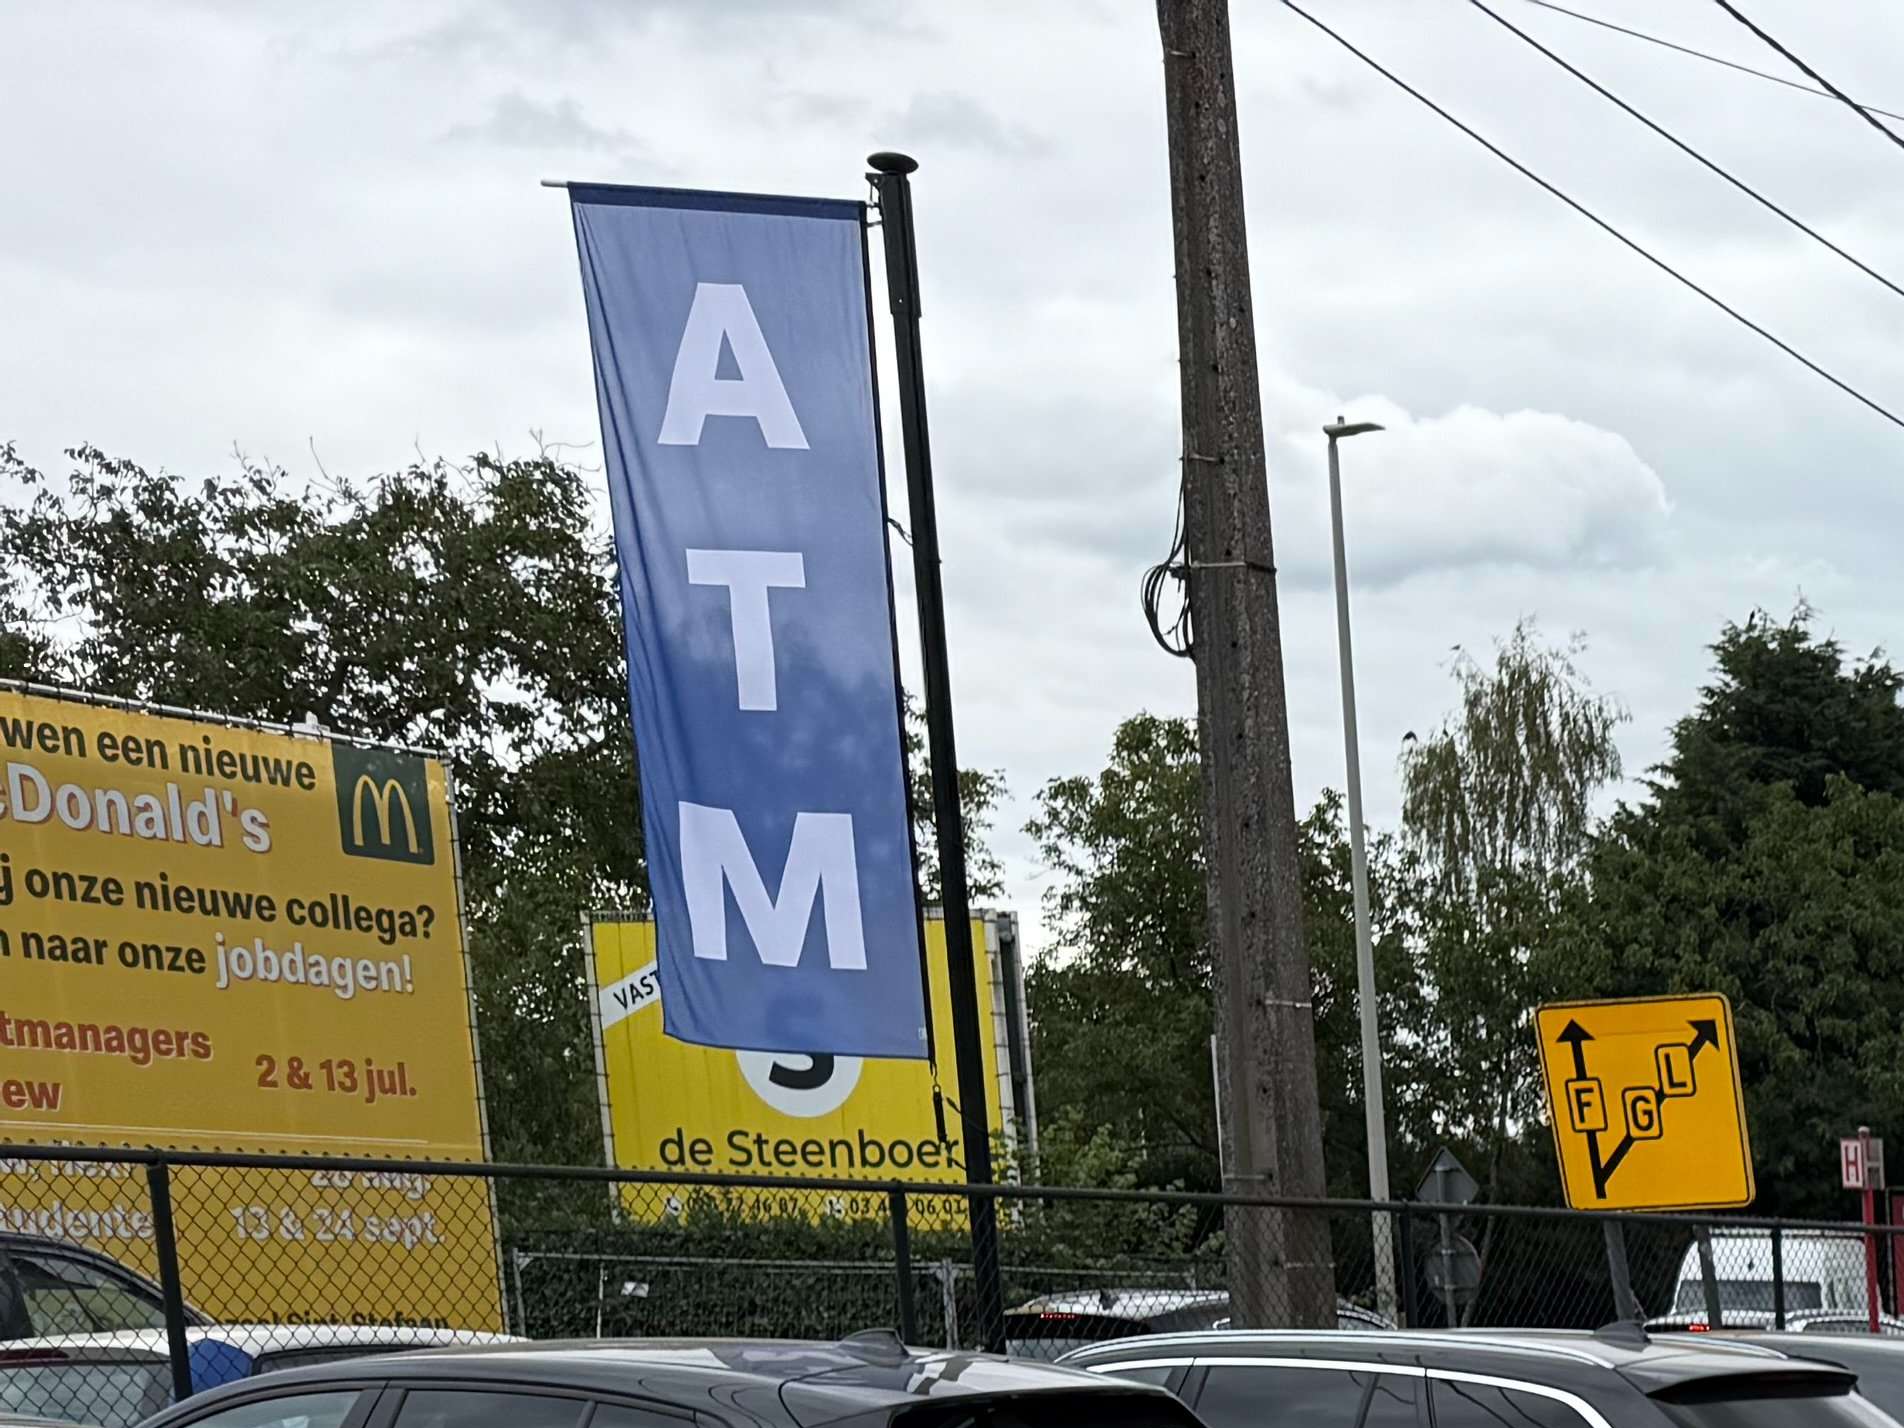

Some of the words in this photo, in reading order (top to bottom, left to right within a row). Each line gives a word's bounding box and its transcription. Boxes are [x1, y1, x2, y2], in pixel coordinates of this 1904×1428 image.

[97, 729, 170, 769] een
[179, 735, 316, 791] nieuwe
[25, 867, 125, 907] onze
[135, 872, 277, 923] nieuwe
[286, 893, 436, 946] collega?
[21, 930, 109, 967] naar
[118, 940, 207, 975] onze
[215, 932, 415, 1000] jobdagen!
[0, 1010, 214, 1067] tmanagers
[255, 1054, 280, 1090] 2
[287, 1056, 314, 1091] &
[320, 1059, 359, 1096] 13
[364, 1057, 419, 1106] jul.
[1663, 1052, 1688, 1089] L
[1574, 1087, 1595, 1124] F
[1630, 1095, 1654, 1132] G
[659, 1128, 714, 1167] de
[1844, 1145, 1860, 1183] H
